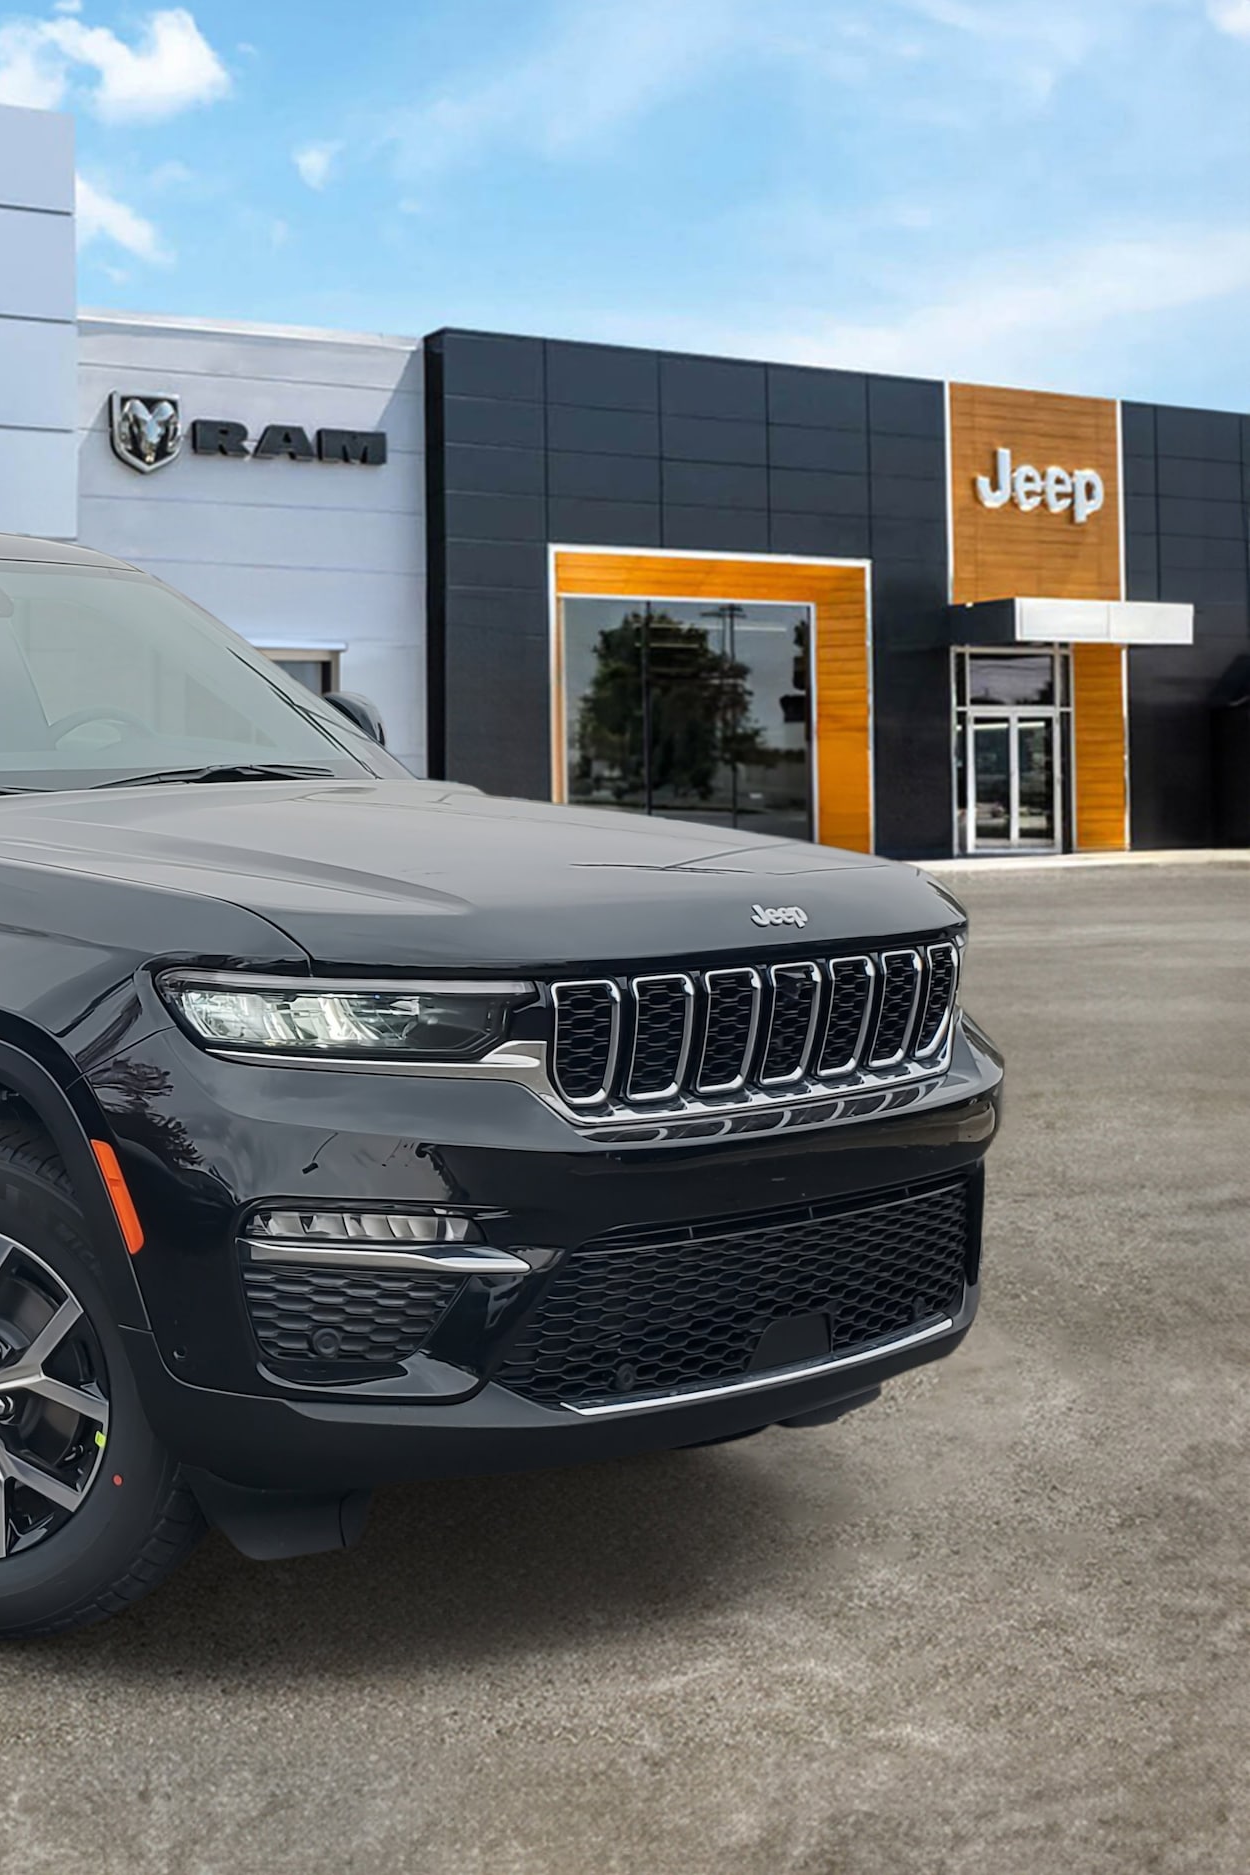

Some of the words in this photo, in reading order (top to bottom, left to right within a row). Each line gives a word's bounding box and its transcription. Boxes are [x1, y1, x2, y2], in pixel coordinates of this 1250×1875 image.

[191, 419, 387, 466] RAM
[976, 447, 1104, 524] Jeep
[751, 904, 808, 928] Jeep
